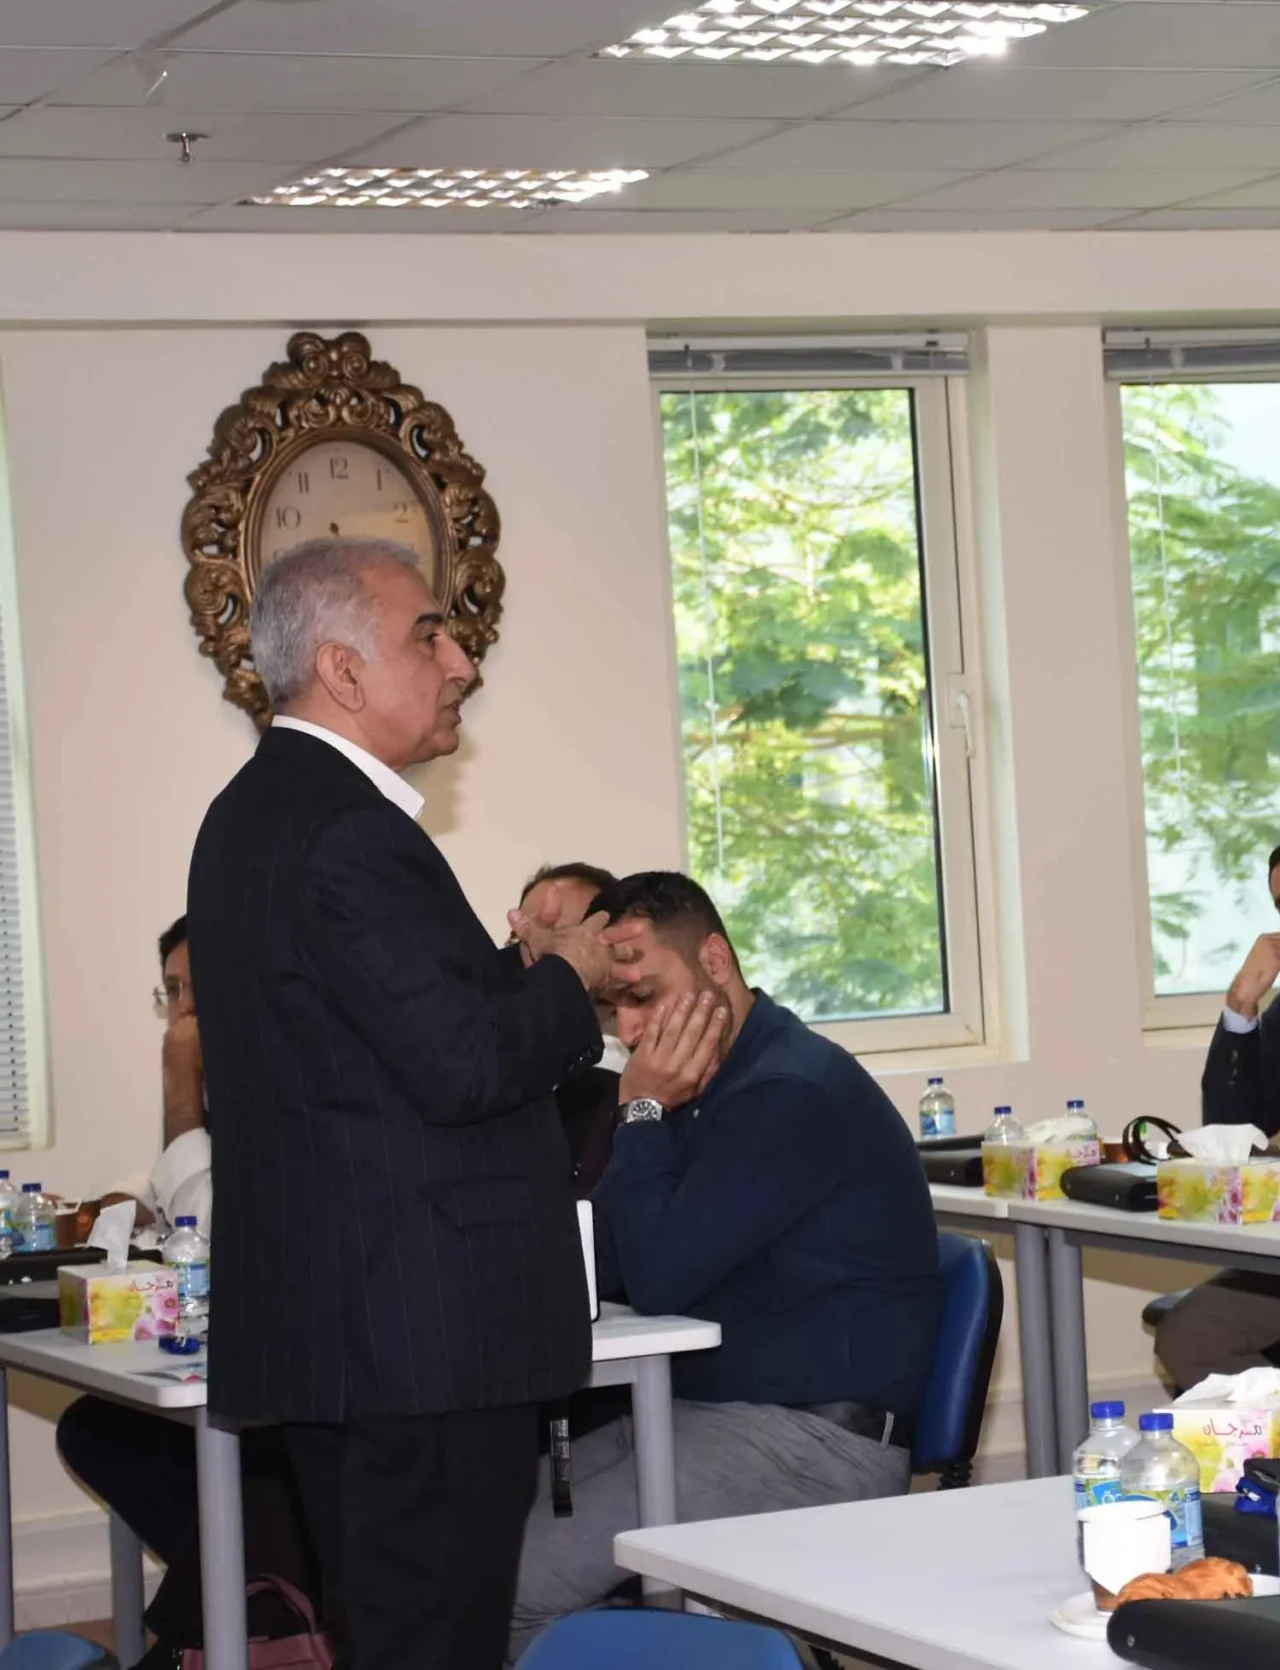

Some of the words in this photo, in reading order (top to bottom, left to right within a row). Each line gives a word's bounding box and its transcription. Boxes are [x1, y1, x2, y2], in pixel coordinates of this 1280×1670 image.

[329, 457, 349, 479] 12
[298, 471, 309, 493] 11
[276, 506, 301, 529] 10
[393, 501, 409, 523] 2
